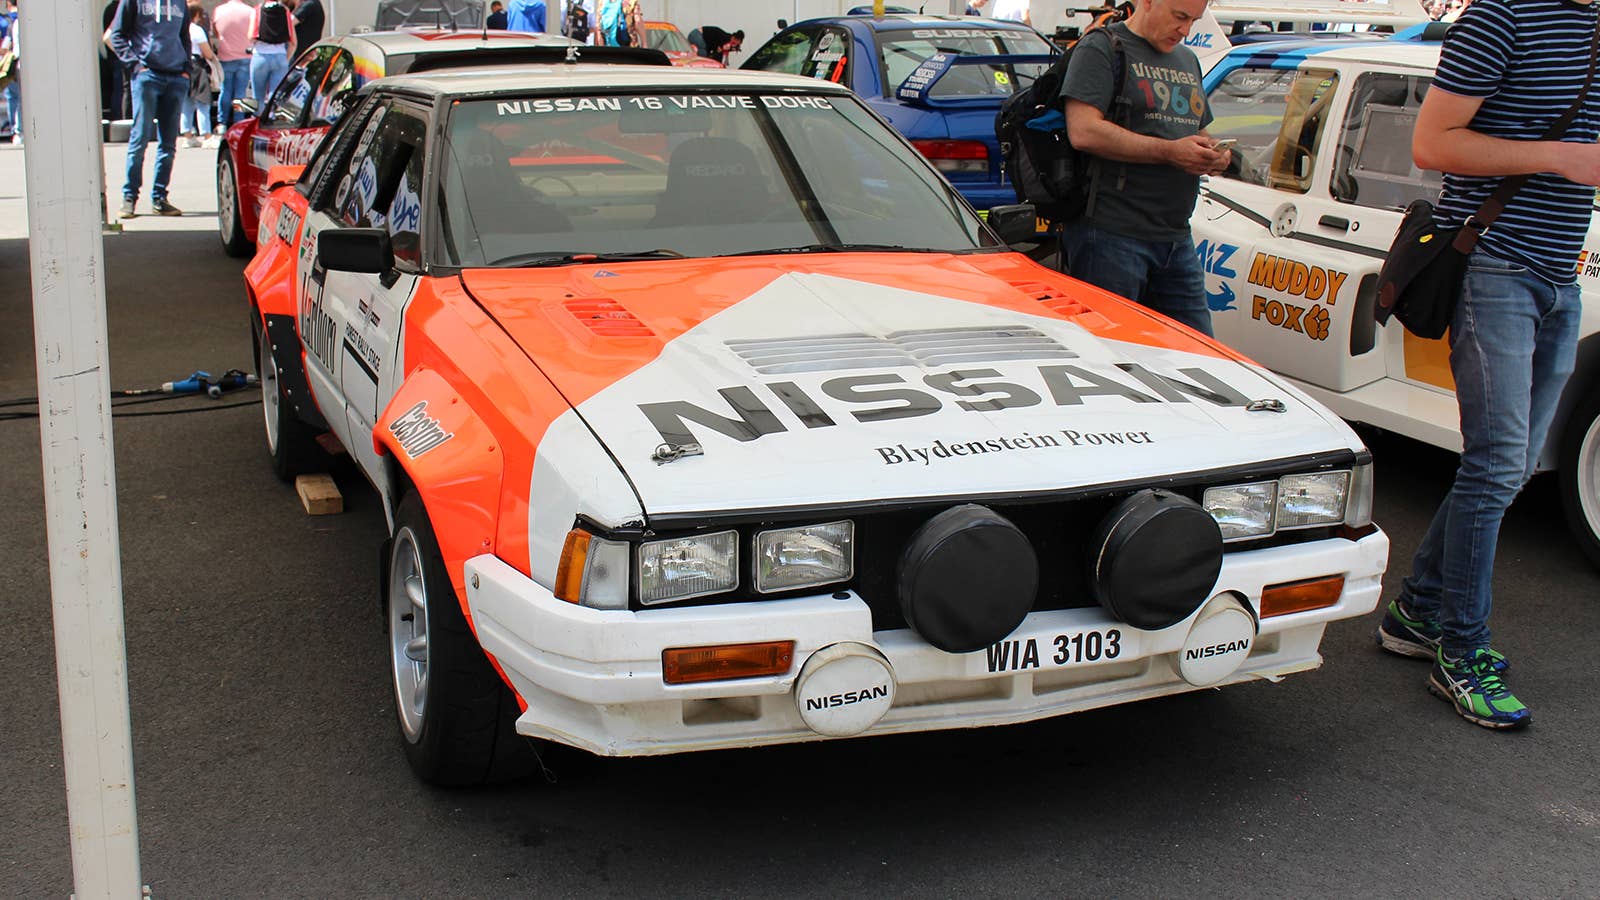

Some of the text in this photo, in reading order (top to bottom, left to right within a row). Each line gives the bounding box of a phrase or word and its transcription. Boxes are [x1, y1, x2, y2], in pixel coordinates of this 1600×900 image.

[912, 28, 1022, 39] SUBARU
[994, 71, 1009, 84] 8
[1131, 62, 1198, 85] VINTAGE
[497, 95, 833, 115] NISSAN 16 VALVE DOHC
[1137, 79, 1205, 117] 1966
[1247, 252, 1348, 305] MUDDY
[1252, 295, 1305, 334] FOX
[638, 361, 1250, 455] NISSAN
[389, 400, 455, 459] Castrol
[874, 429, 1156, 466] Blydenstein Power
[986, 628, 1121, 673] WIA 3103
[1186, 638, 1250, 661] NISSAN
[806, 684, 888, 711] NISSAN
